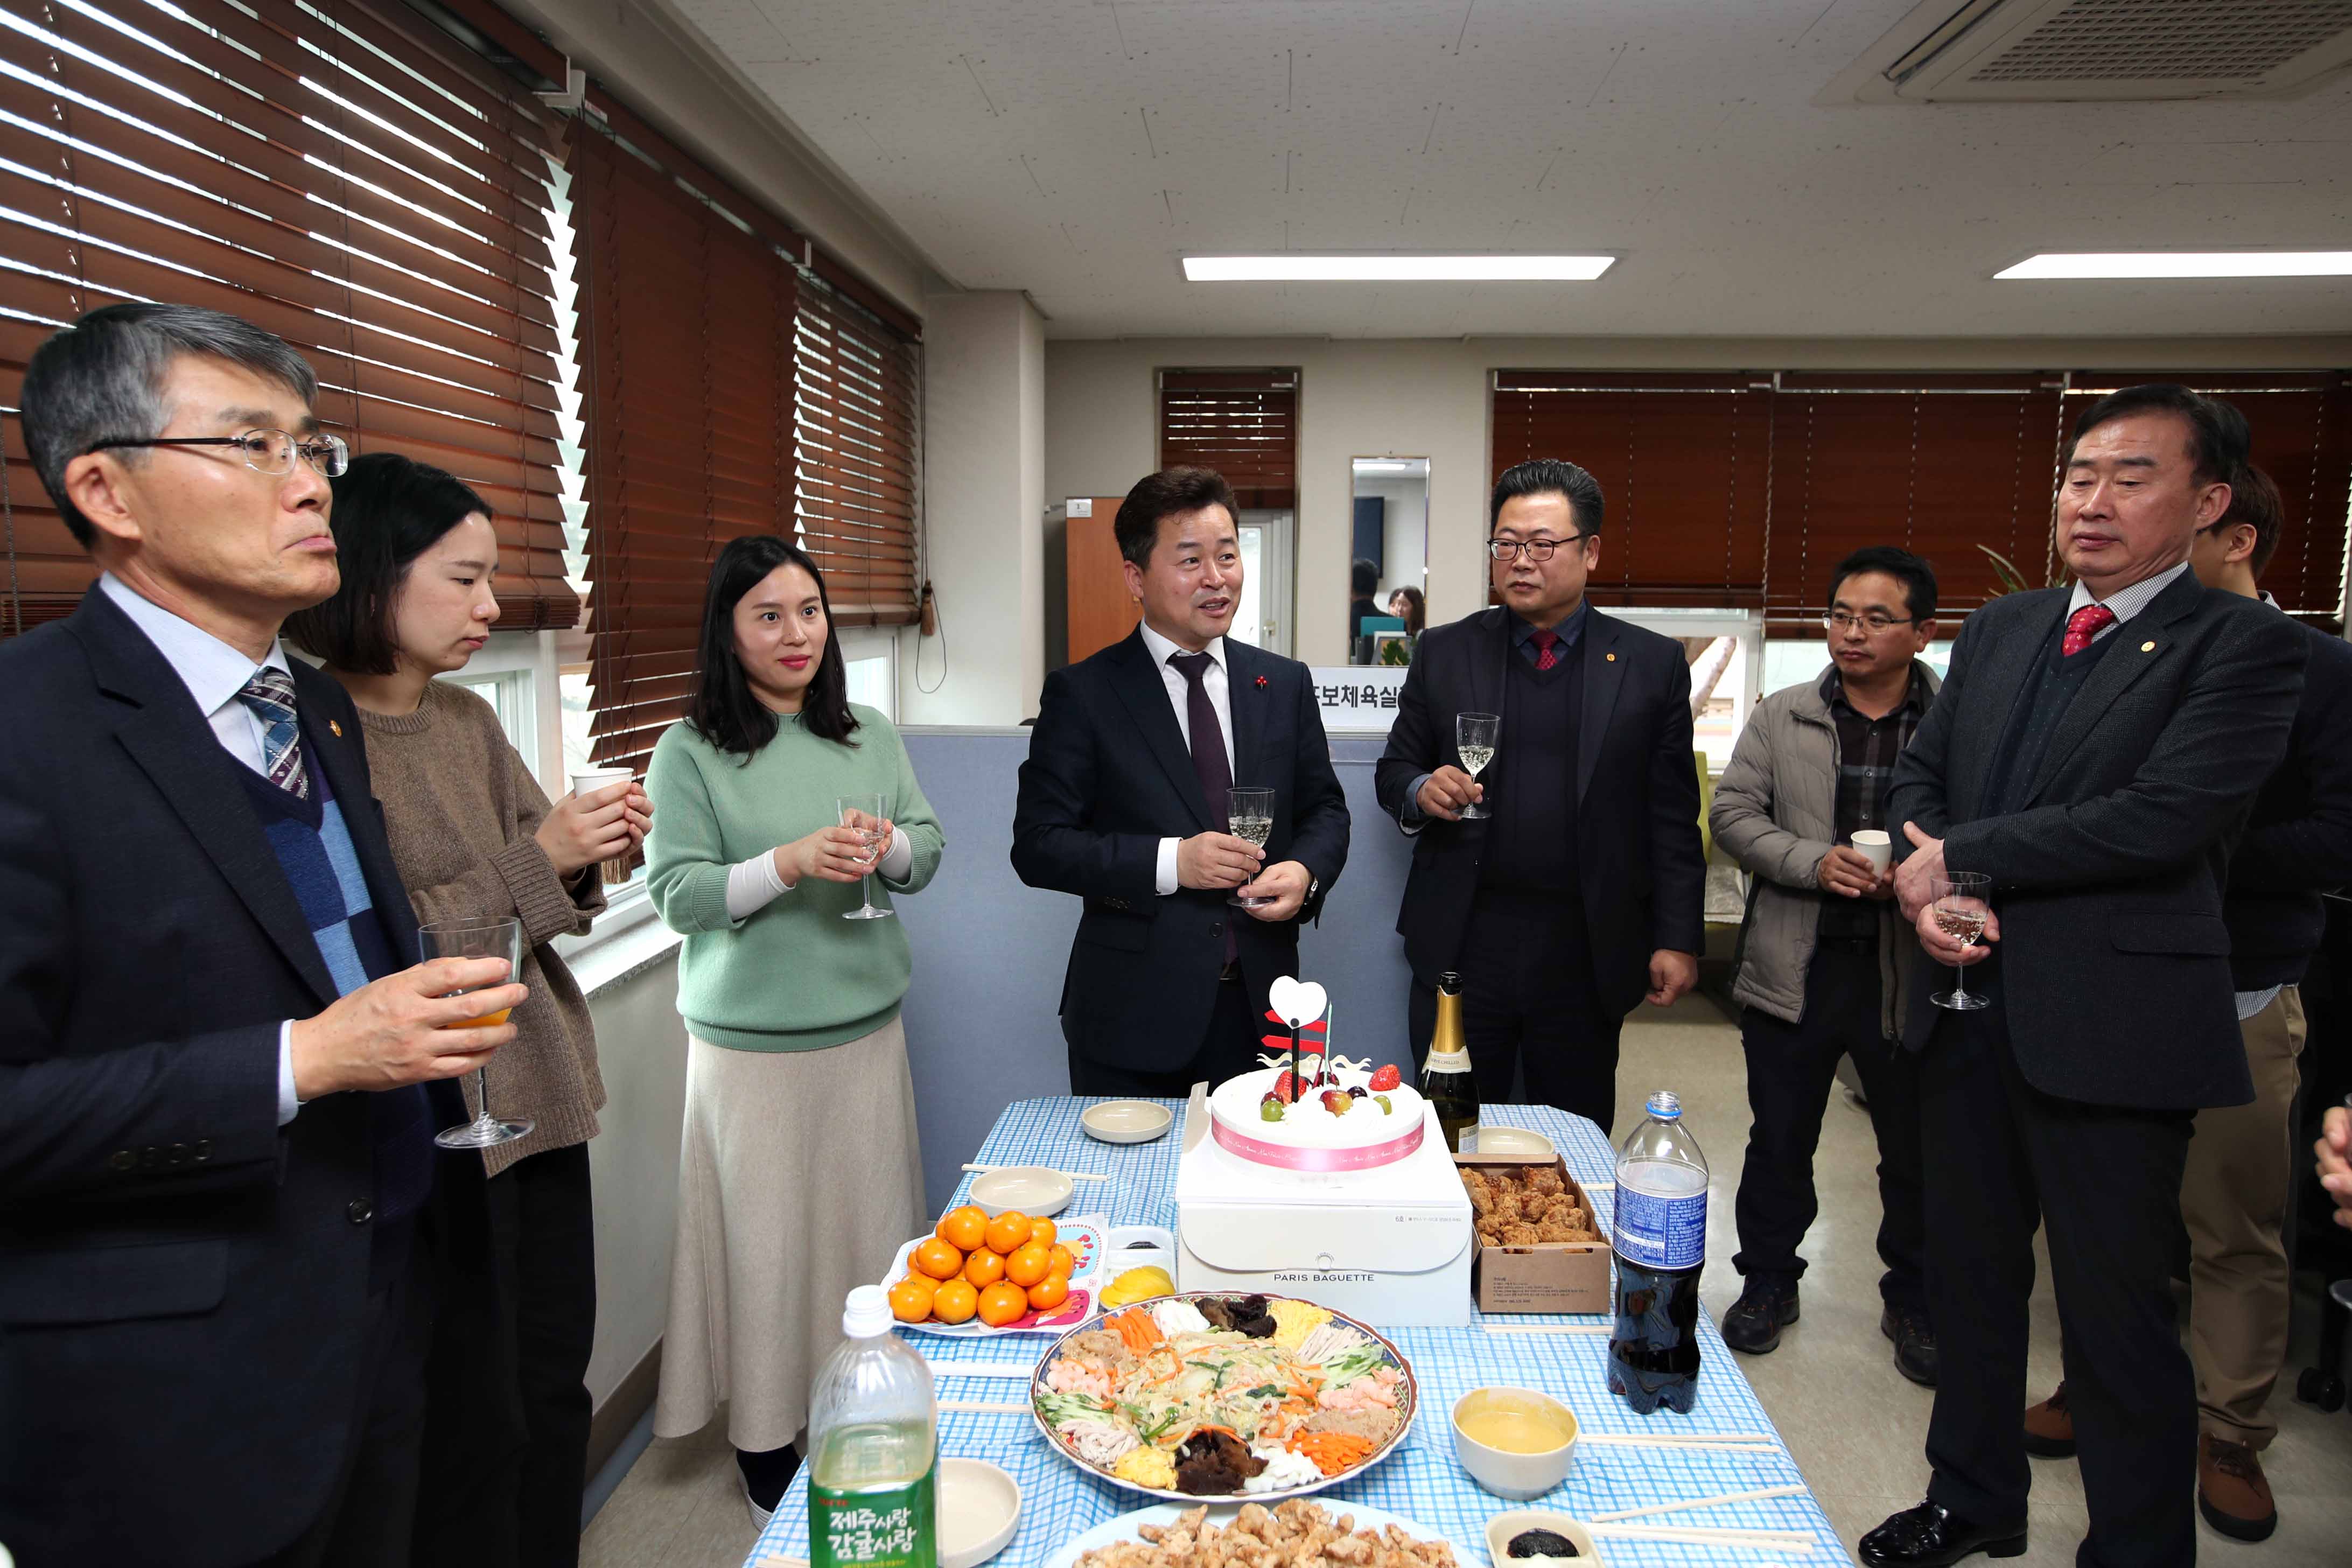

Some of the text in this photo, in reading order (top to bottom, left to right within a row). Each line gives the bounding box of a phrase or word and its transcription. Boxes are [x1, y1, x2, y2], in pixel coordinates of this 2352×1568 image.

[1313, 684, 1402, 708] 보체육실
[830, 1507, 912, 1530] 제주사랑
[827, 1527, 917, 1560] 감귤사랑
